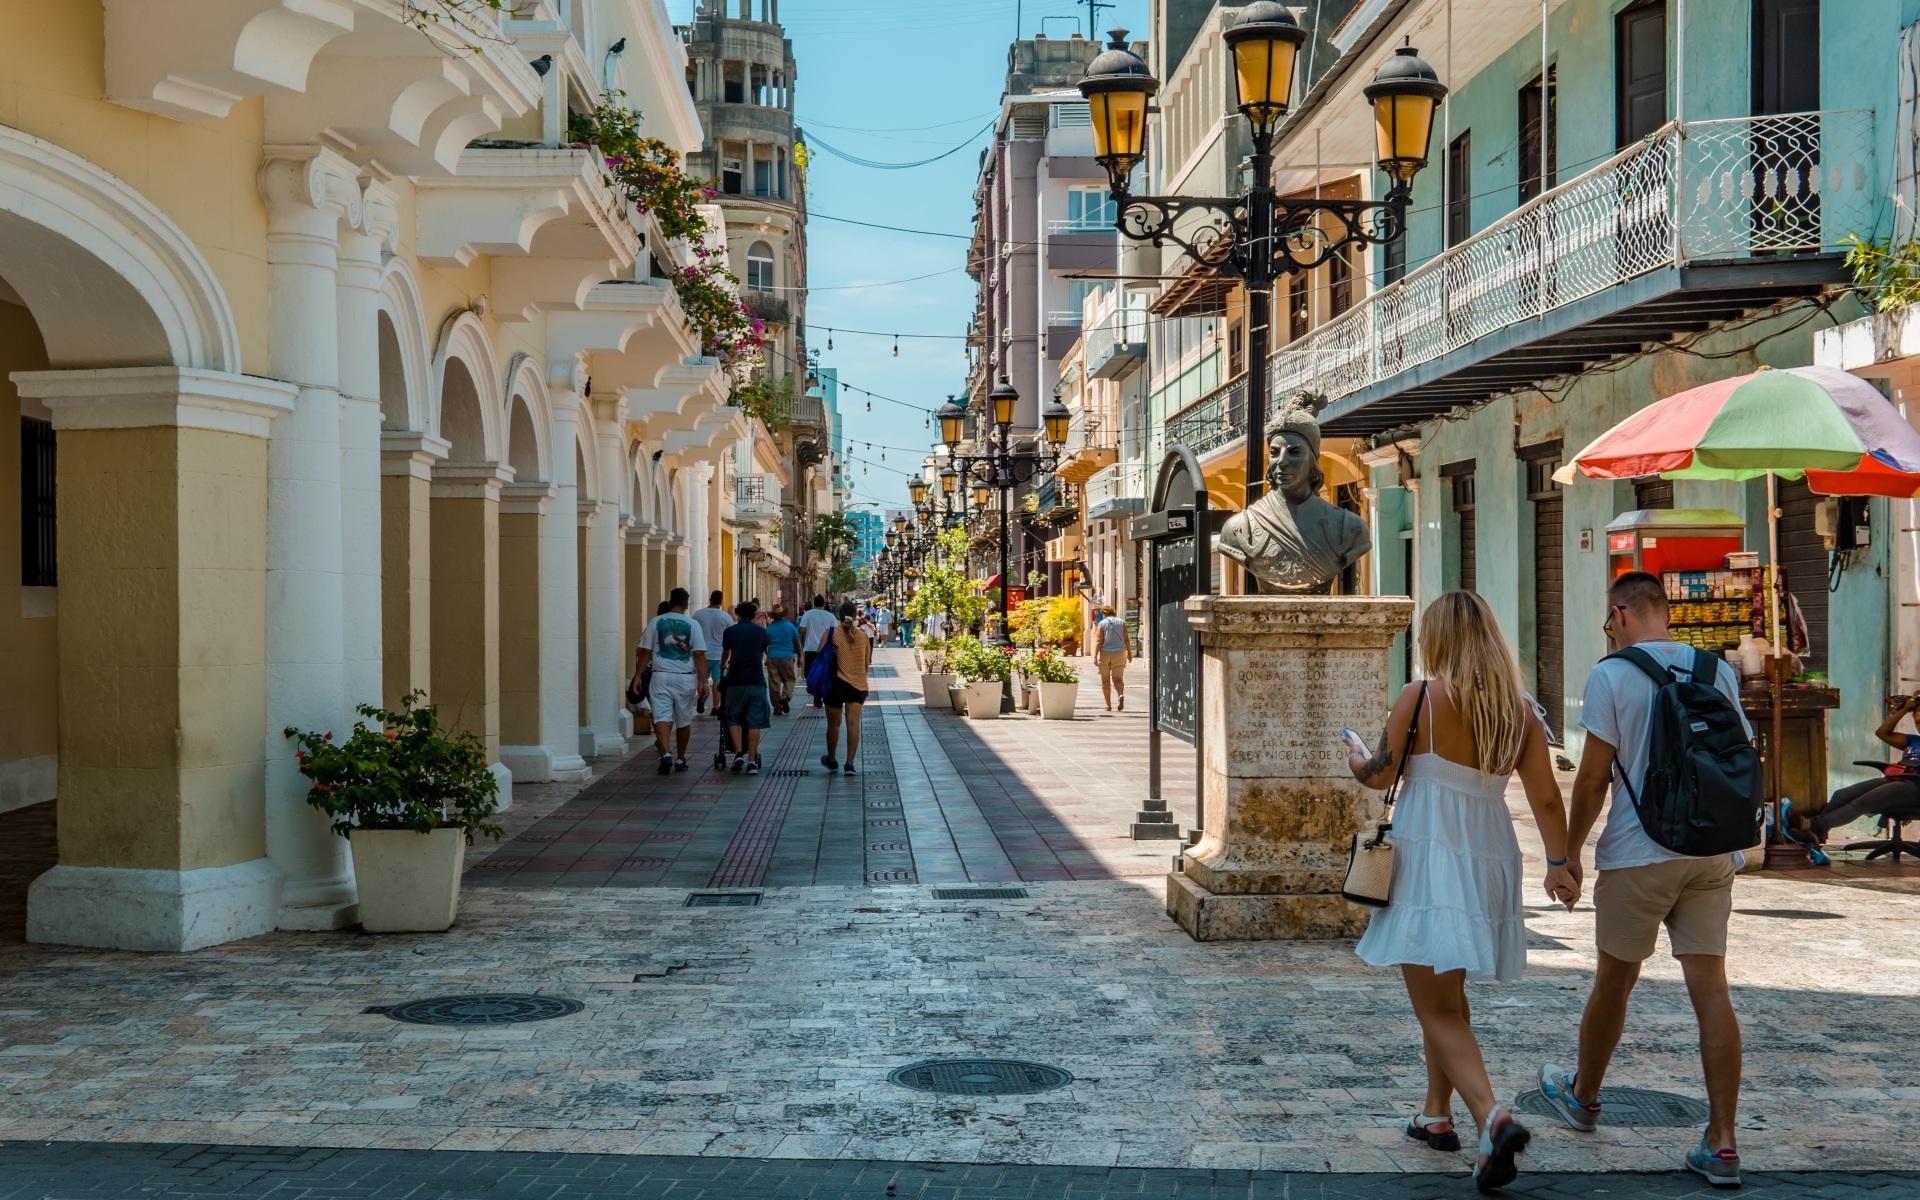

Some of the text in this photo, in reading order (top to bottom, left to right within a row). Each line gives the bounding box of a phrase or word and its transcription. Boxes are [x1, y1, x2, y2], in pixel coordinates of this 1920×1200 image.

[1243, 650, 1290, 659] HOMENAJE
[1292, 651, 1306, 659] DEL
[1249, 661, 1259, 669] DE
[1301, 661, 1311, 669] AL
[1314, 661, 1369, 669] ADELANTADO
[1238, 670, 1264, 681] DON
[1342, 683, 1384, 691] ORIENTAL
[1319, 750, 1332, 760] DE
